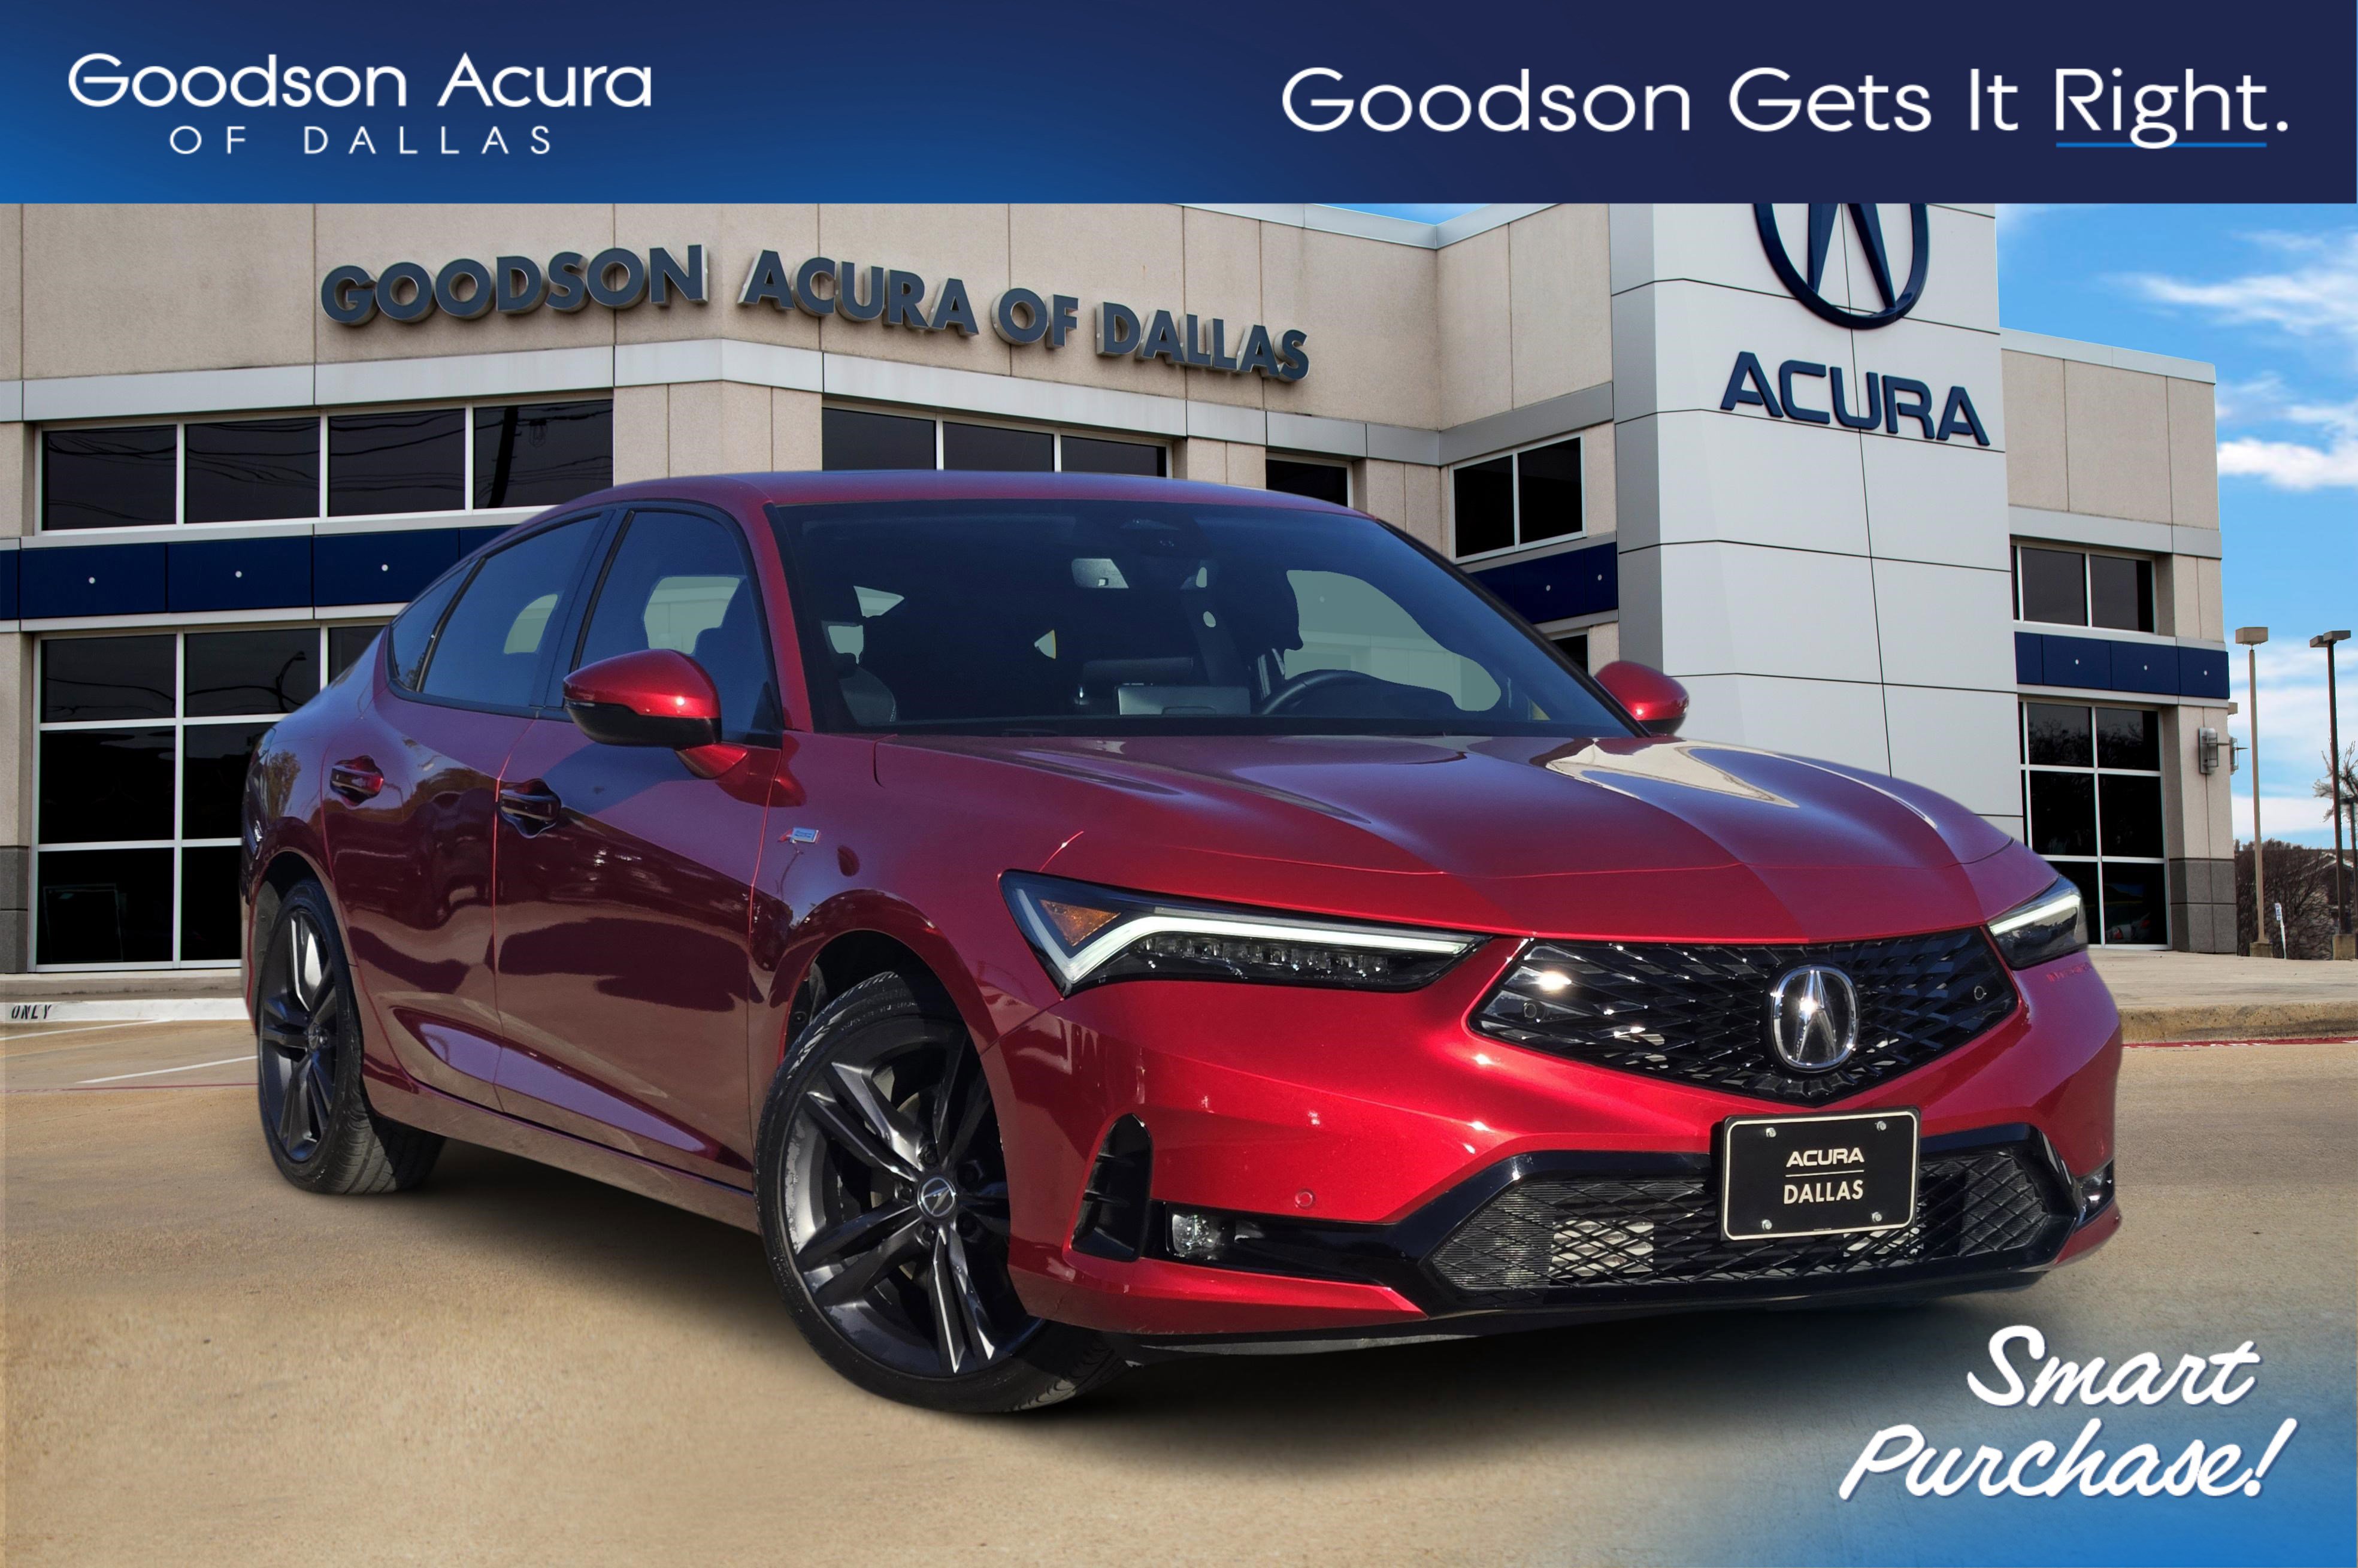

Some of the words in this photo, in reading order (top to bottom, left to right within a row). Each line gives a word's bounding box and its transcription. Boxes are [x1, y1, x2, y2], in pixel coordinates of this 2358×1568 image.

[321, 244, 708, 326] GOODSON
[737, 249, 979, 337] ACURA
[991, 287, 1079, 349] OF
[1095, 301, 1310, 383] DALLAS
[1720, 352, 1991, 447] ACURA
[11, 1004, 52, 1020] ONLY
[1786, 1147, 1864, 1168] ACURA
[1784, 1179, 1864, 1204] DALLAS
